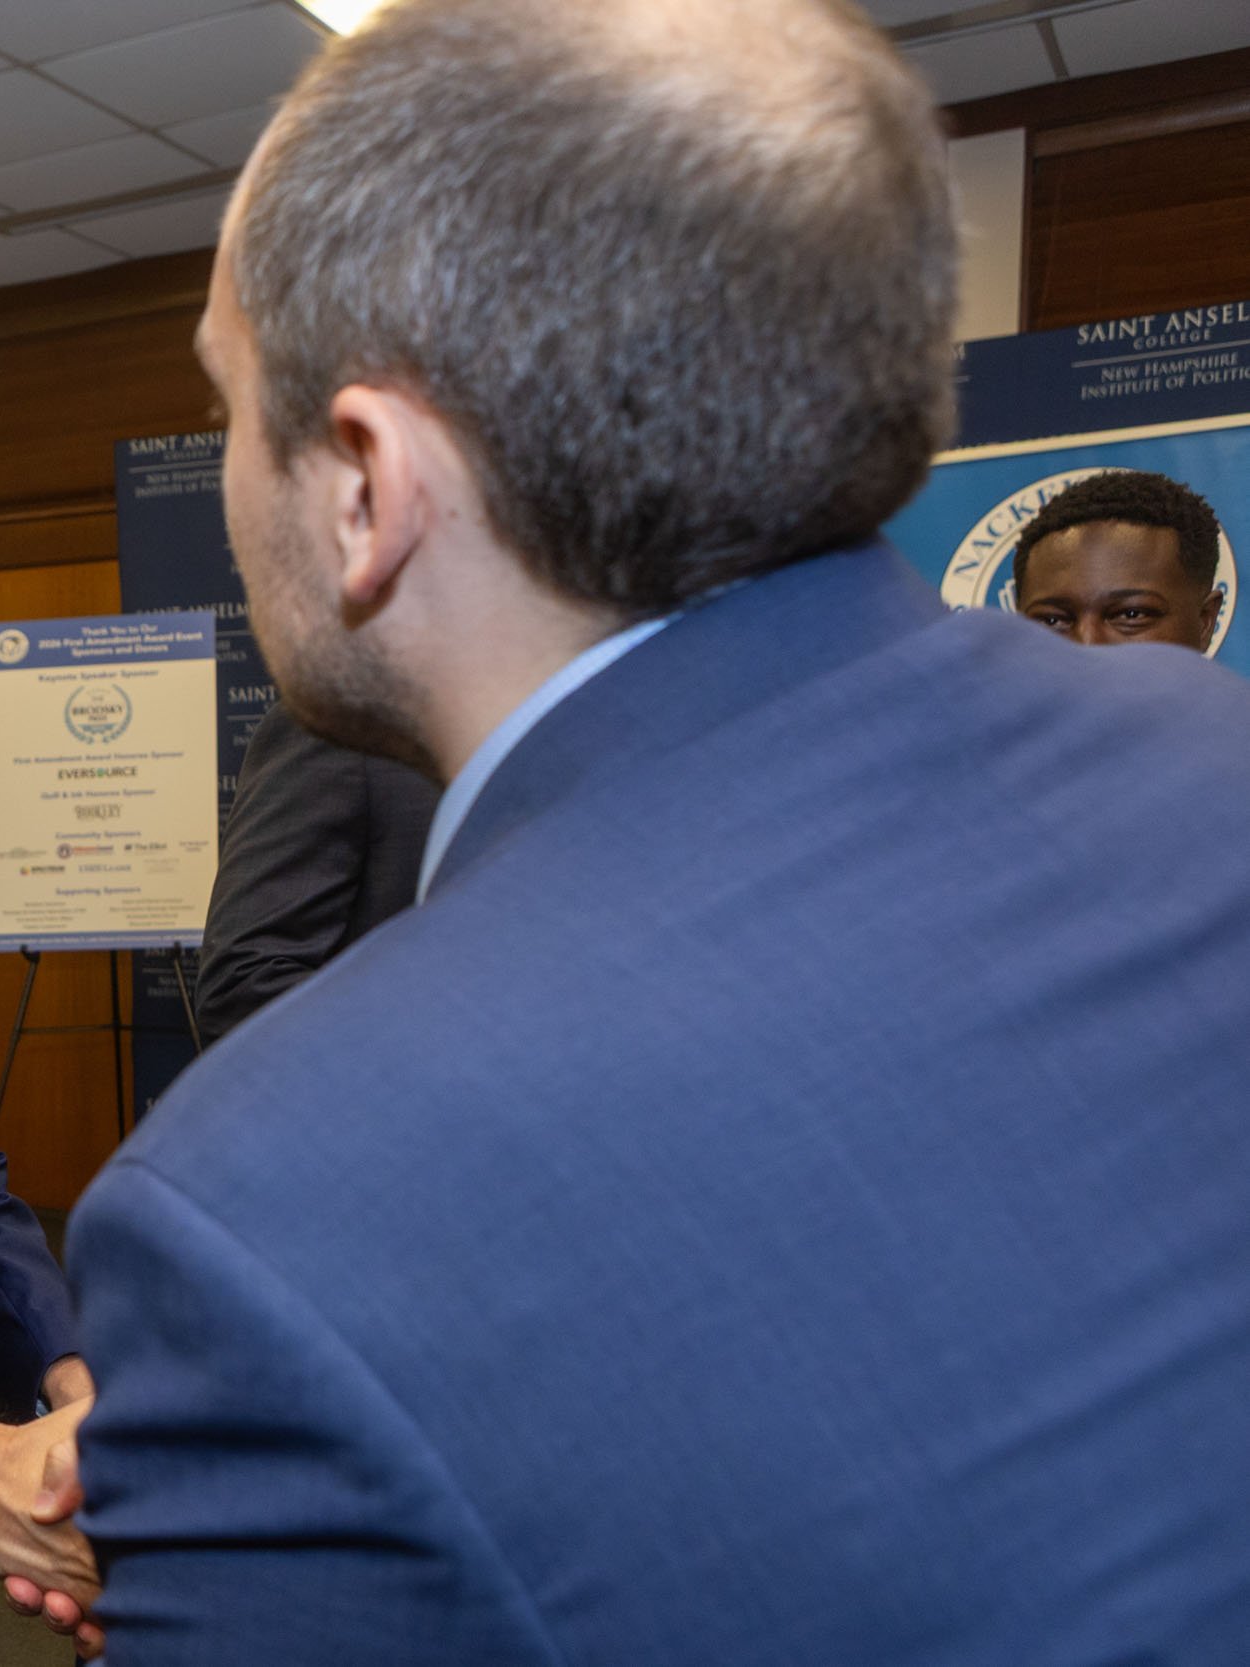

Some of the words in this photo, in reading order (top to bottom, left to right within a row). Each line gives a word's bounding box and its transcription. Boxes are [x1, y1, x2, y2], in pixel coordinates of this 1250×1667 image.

[1077, 314, 1156, 346] SAINT
[1133, 328, 1212, 350] COLLEGE
[1101, 366, 1140, 383] NEW
[1145, 352, 1239, 377] HAMPSHIRE
[1081, 378, 1159, 401] INSTITUTE
[1165, 375, 1187, 390] OF
[129, 434, 176, 456] SAINT
[86, 635, 141, 646] Amendment
[144, 633, 174, 643] Award
[176, 631, 203, 641] Event
[57, 766, 138, 780] EVERSOURCE
